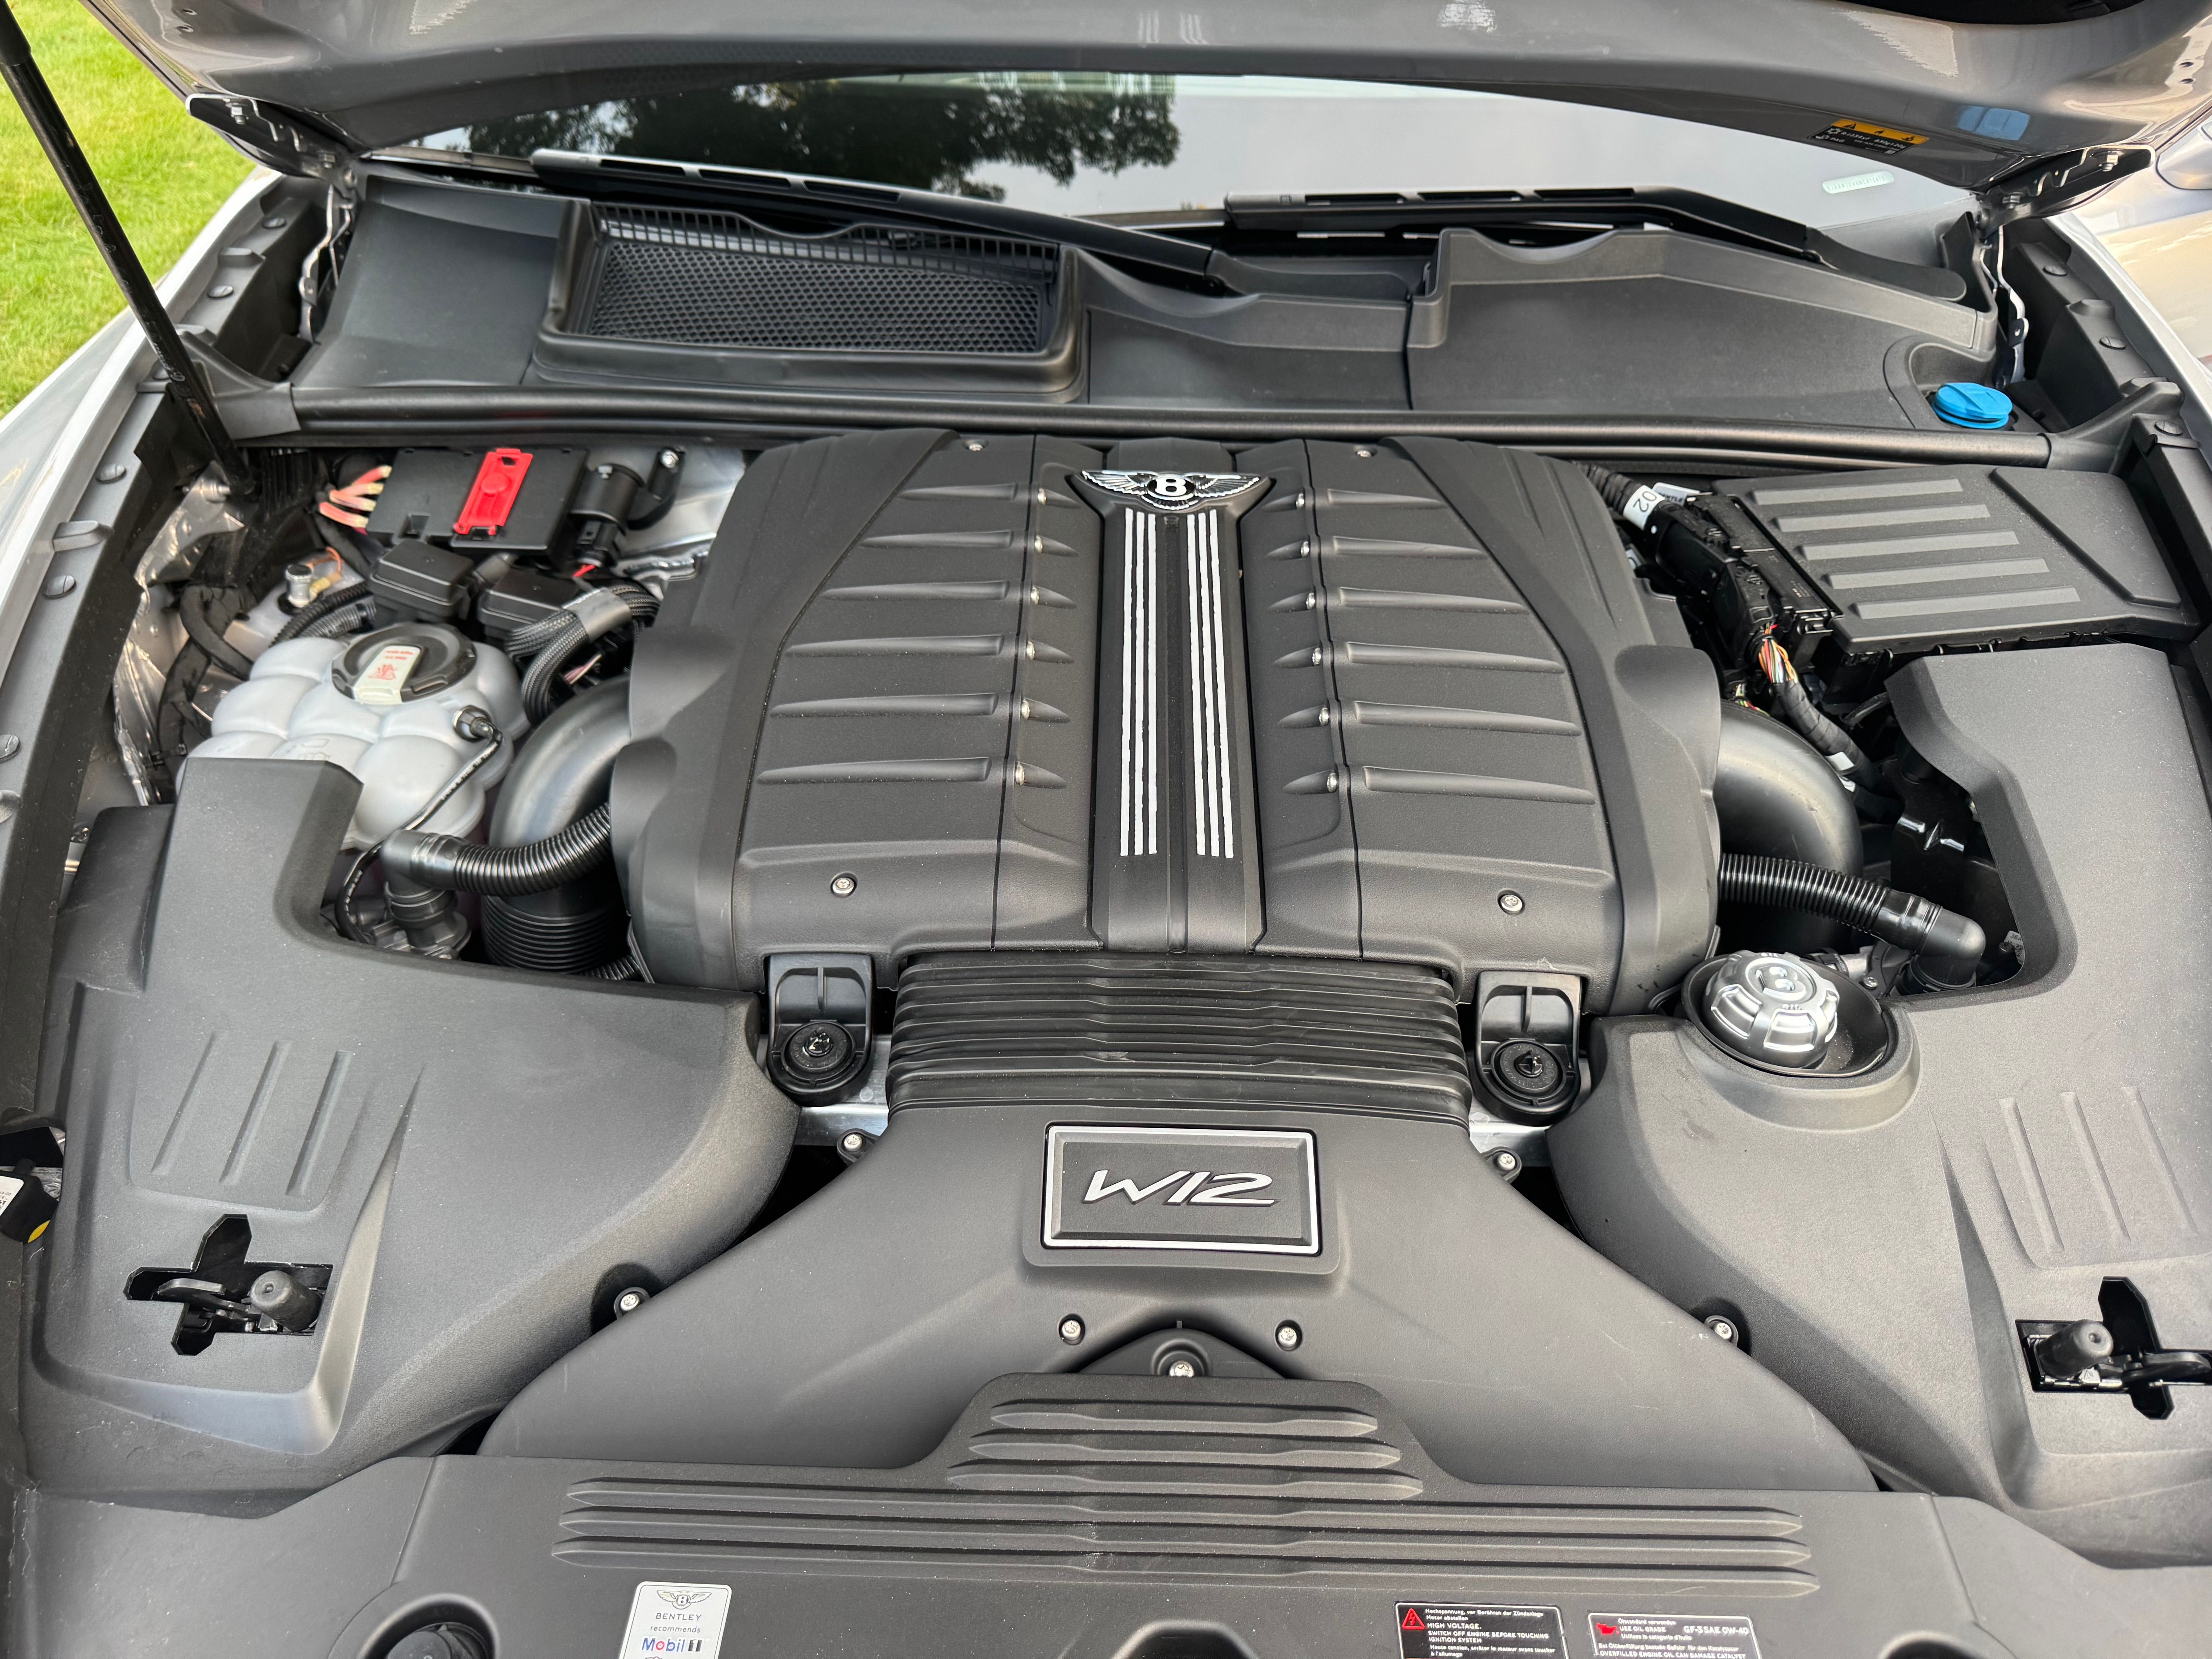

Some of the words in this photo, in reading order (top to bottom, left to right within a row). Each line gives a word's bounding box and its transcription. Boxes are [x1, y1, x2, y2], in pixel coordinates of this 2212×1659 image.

[1083, 1170, 1277, 1206] W12
[656, 1613, 702, 1621] BENTLEY
[642, 1637, 685, 1652] Mobil
